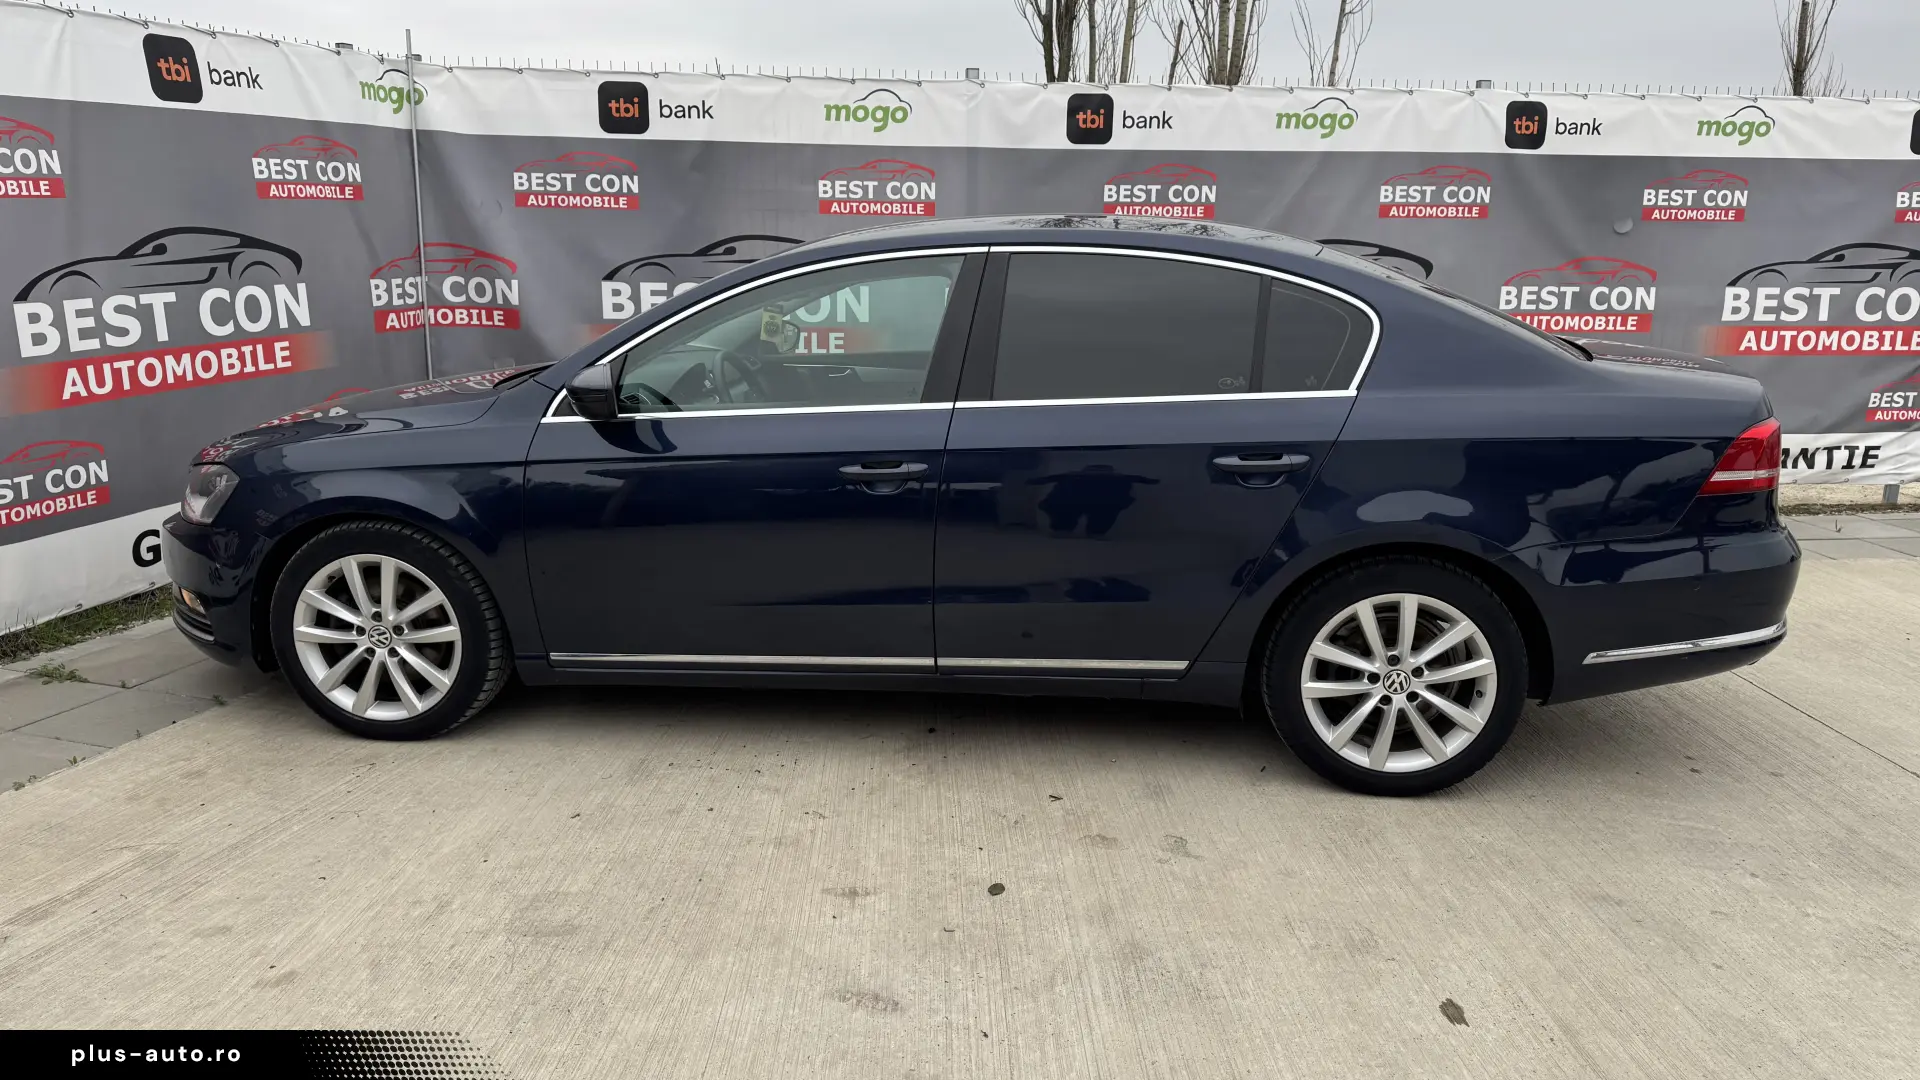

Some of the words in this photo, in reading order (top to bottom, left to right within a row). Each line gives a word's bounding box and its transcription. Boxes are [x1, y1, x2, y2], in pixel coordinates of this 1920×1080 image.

[157, 57, 192, 83] tbi
[206, 61, 263, 90] bank
[360, 81, 425, 114] mogo
[608, 98, 639, 118] tbi
[659, 98, 714, 120] bank
[824, 103, 909, 132] mogo
[1076, 109, 1105, 129] tbi
[1122, 110, 1173, 129] bank
[1275, 111, 1355, 139] mogo
[1513, 115, 1540, 135] tbi
[1554, 117, 1603, 136] bank
[1697, 119, 1771, 146] mogo
[252, 157, 309, 181] BEST
[316, 160, 362, 183] CON
[269, 183, 354, 199] AUTOMOBILE
[513, 172, 577, 192] BEST
[585, 173, 639, 194] CON
[818, 180, 879, 199] BEST
[885, 181, 936, 200] CON
[1103, 184, 1162, 203] BEST
[1168, 184, 1217, 203] CON
[527, 194, 628, 208] AUTOMOBILE
[1379, 185, 1436, 203] BEST
[1442, 185, 1491, 204] CON
[1642, 188, 1697, 207] BEST
[1703, 189, 1749, 207] CON
[830, 202, 925, 215] AUTOMOBILE
[1114, 205, 1205, 217] AUTOMOBILE
[1388, 206, 1480, 218] AUTOMOBILE
[1651, 209, 1736, 221] AUTOMOBILE
[369, 276, 428, 307] BEST
[442, 275, 520, 306] CON
[1499, 285, 1581, 311] BEST
[1588, 286, 1657, 311] CON
[1721, 286, 1841, 322] BEST
[1855, 286, 1920, 322] CO
[12, 291, 177, 358] BEST
[199, 282, 311, 337] CON
[386, 308, 505, 329] AUTOMOBILE
[62, 341, 292, 400] AUTOMOBILE
[1868, 391, 1918, 408] BEST
[45, 459, 109, 494] CON
